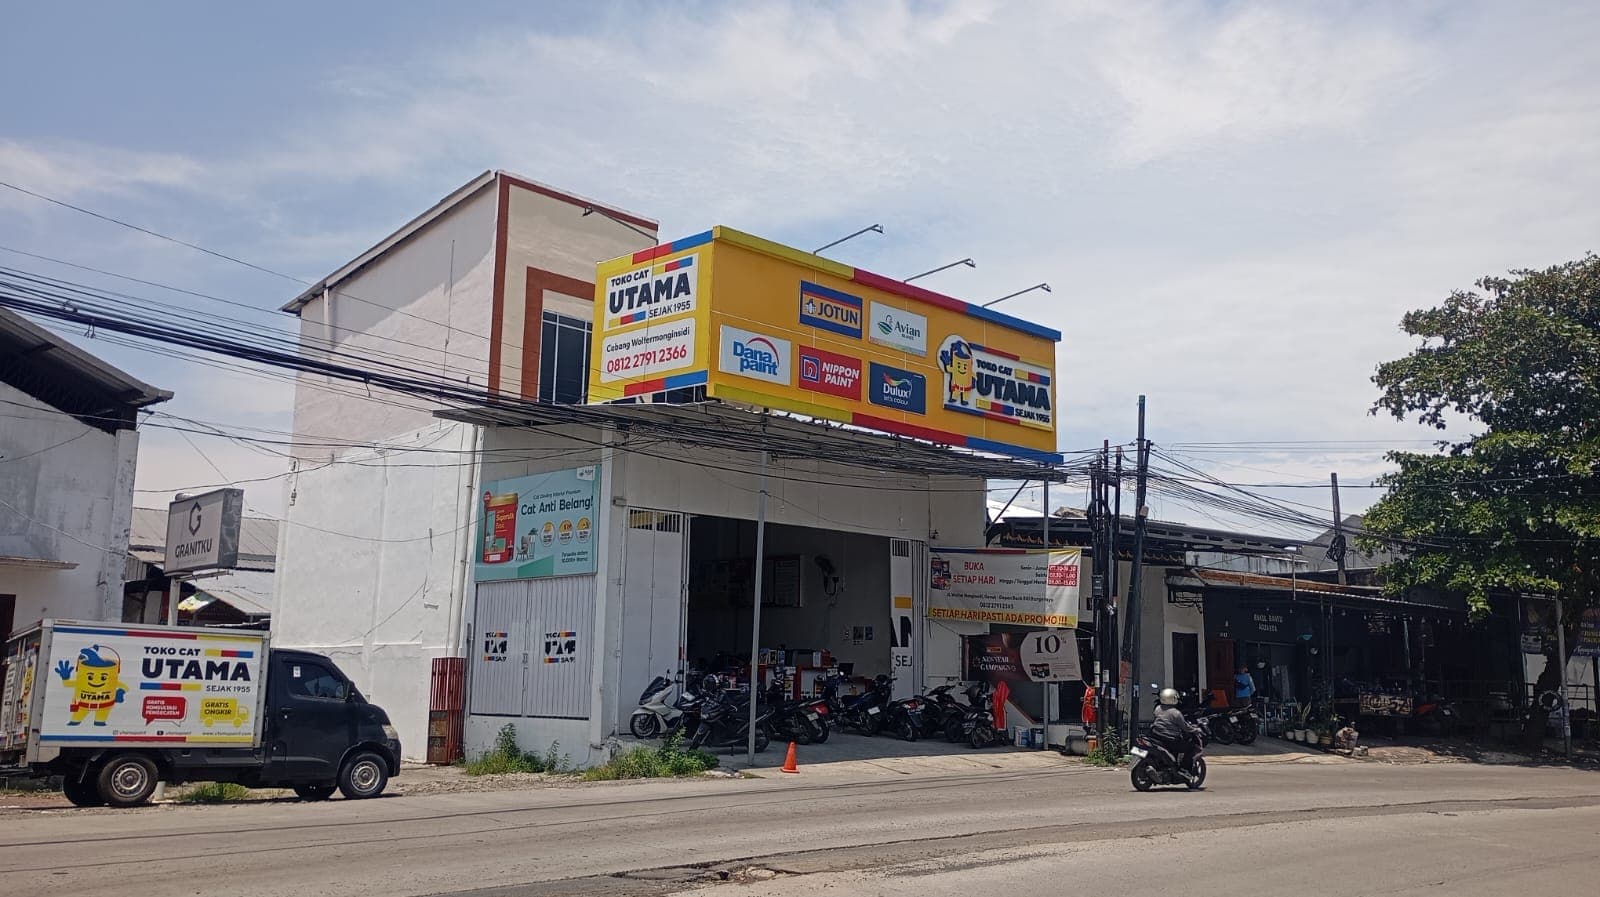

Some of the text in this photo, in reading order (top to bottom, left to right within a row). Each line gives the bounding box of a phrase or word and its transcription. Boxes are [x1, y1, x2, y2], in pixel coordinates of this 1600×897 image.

[611, 269, 649, 287] TOKO CAT
[609, 272, 691, 314] UTAMA
[649, 300, 691, 318] SEJAK 1955
[818, 302, 858, 326] JOTUN
[894, 321, 920, 338] Avian
[606, 339, 631, 353] Cabang
[733, 341, 772, 363] Dana
[607, 345, 687, 373] 0812 2791 2366
[739, 357, 778, 376] paint
[976, 359, 1013, 376] TOKO CAT
[822, 362, 860, 379] NIPPON
[825, 373, 854, 388] PAINT
[883, 383, 909, 398] Dulux
[976, 372, 1050, 411] UTAMA
[1015, 408, 1050, 423] SEJAK 1955
[521, 495, 594, 515] Cat Anti Belang!
[175, 538, 213, 558] GRANITKU
[964, 561, 984, 571] BUKA
[953, 575, 996, 585] SETIAP HARI
[932, 608, 960, 618] SETIAP
[961, 610, 980, 620] HARI
[982, 611, 1004, 621] PASTI
[1006, 614, 1023, 623] ADA
[1025, 615, 1057, 625] PROMO
[144, 647, 200, 656] TOKO CAT
[142, 658, 251, 681] UTAMA
[206, 684, 231, 692] SEJAK
[80, 693, 110, 701] UTAMA
